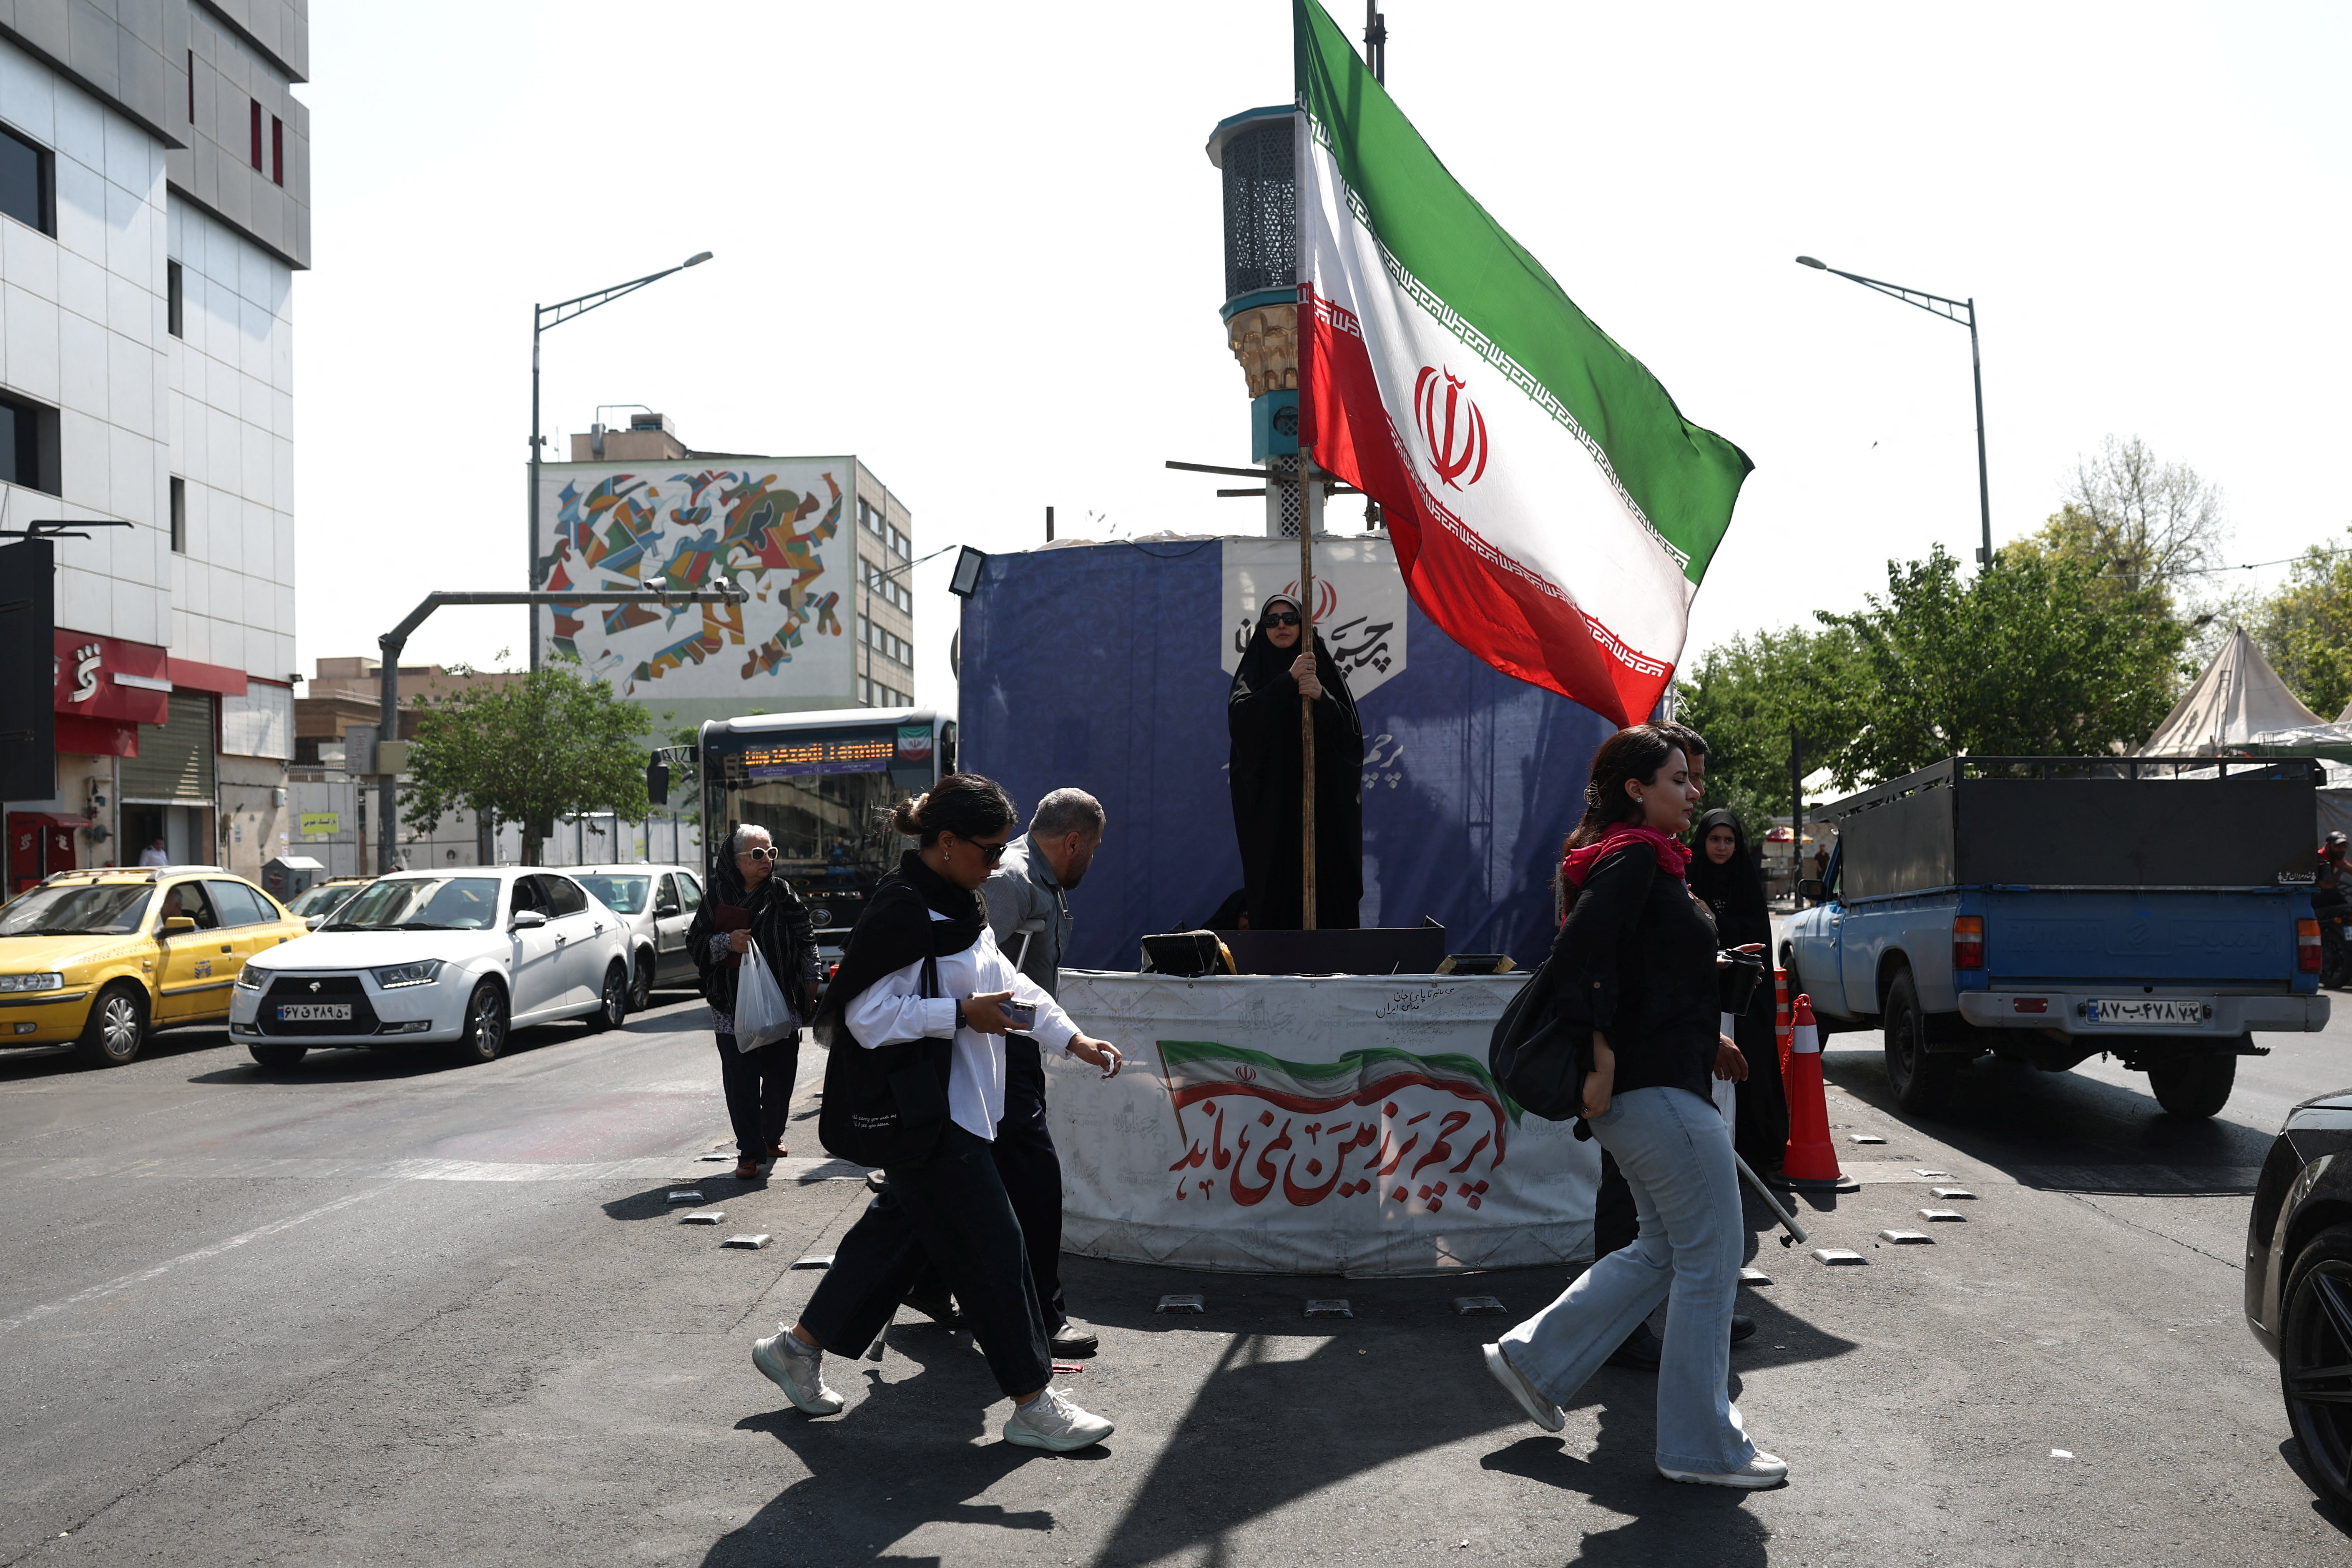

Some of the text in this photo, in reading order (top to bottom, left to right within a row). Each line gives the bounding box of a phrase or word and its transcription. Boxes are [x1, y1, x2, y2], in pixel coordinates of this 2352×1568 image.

[1393, 989, 1408, 1002] جان
[1376, 1003, 1420, 1019] فدای ایران
[1173, 1018, 1219, 1027] @mal_jaee
[1314, 1019, 1366, 1029] @mal_jaee
[1169, 1100, 1231, 1173] ماند
[1230, 1110, 1292, 1207] نمی
[1283, 1101, 1399, 1206] زمین
[1412, 1111, 1491, 1213] پرچم
[1117, 1174, 1157, 1186] @mal_jaee
[1528, 1176, 1571, 1188] @mal_jaee
